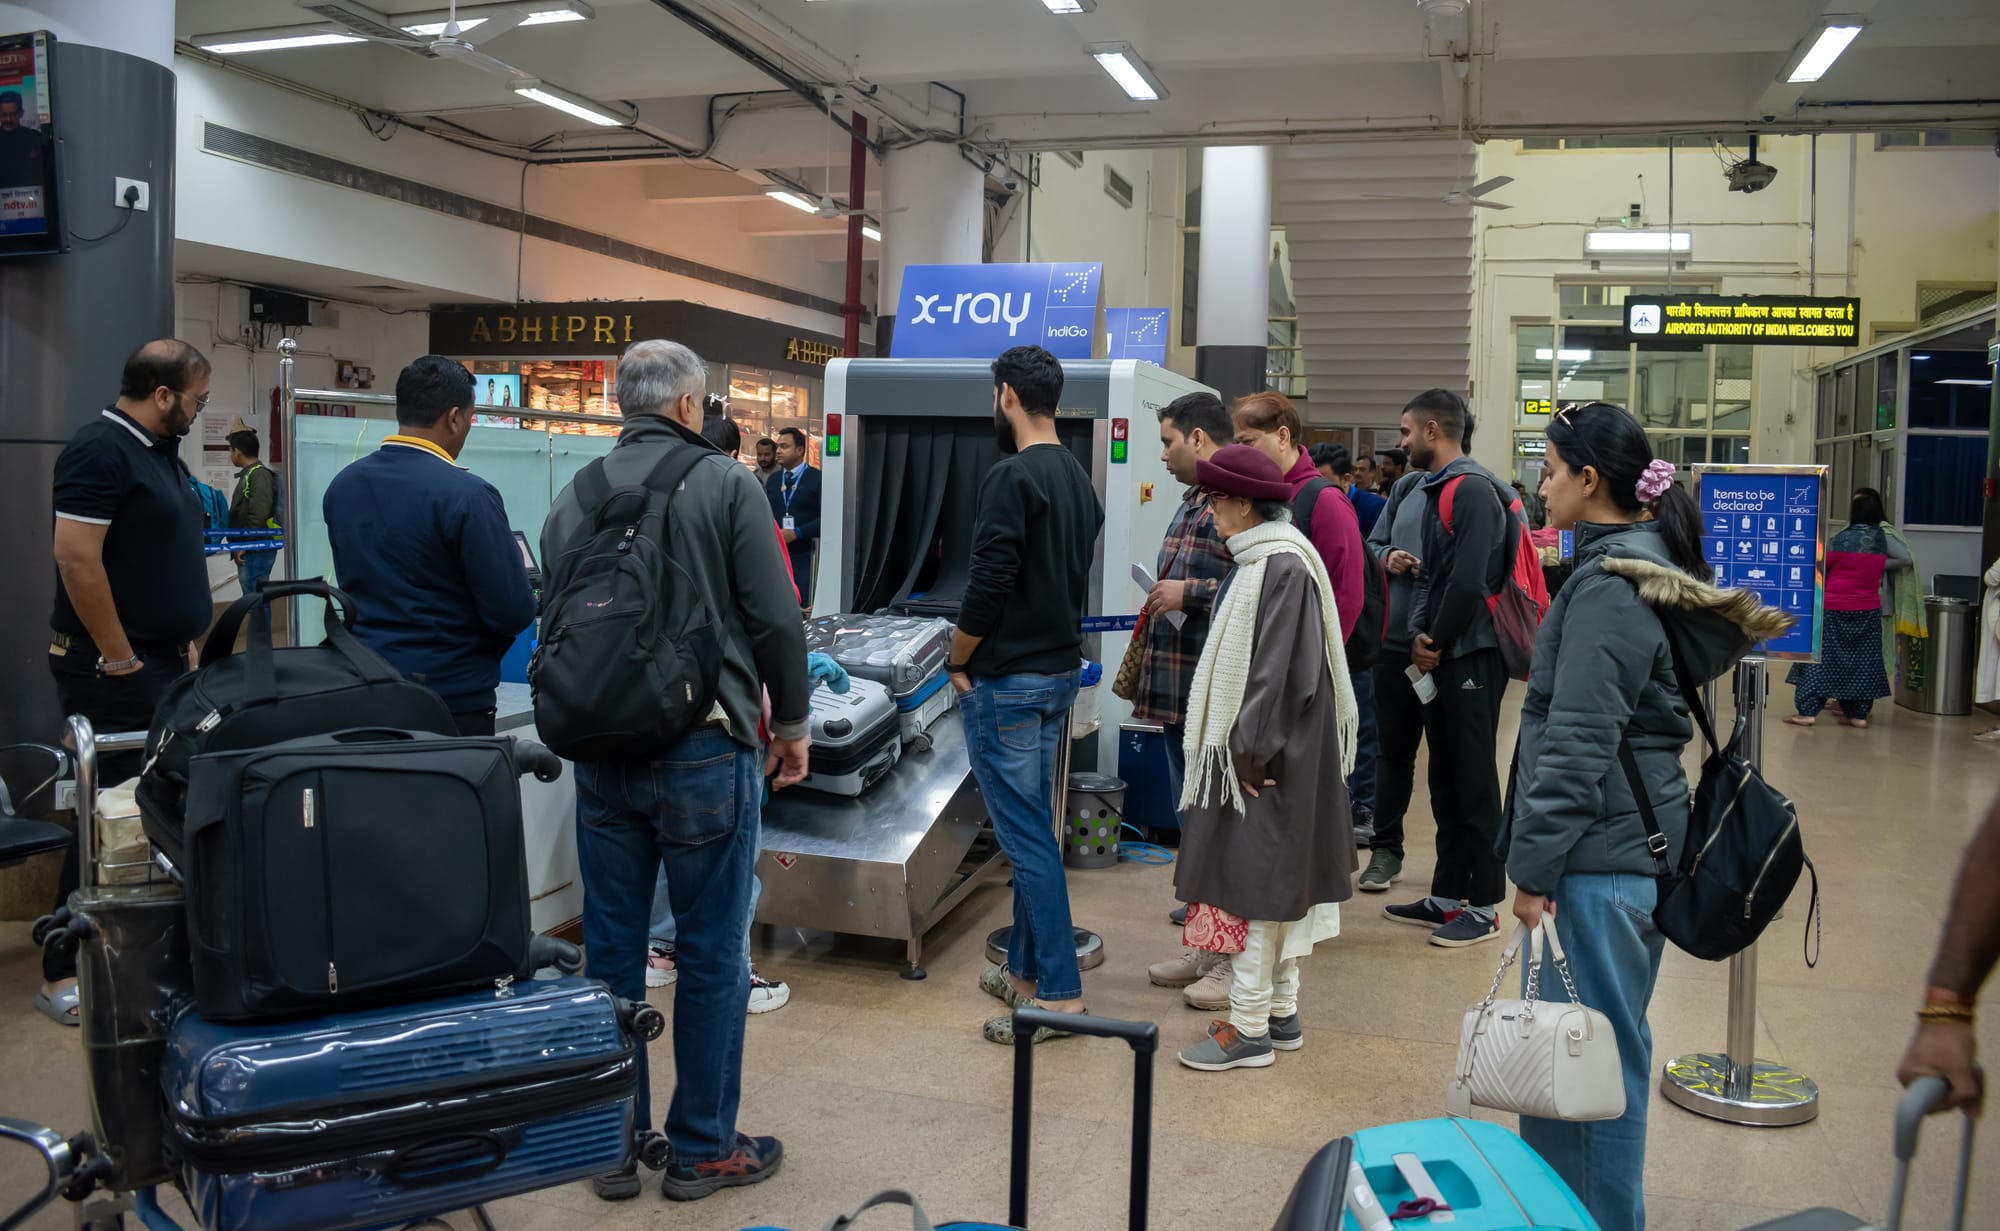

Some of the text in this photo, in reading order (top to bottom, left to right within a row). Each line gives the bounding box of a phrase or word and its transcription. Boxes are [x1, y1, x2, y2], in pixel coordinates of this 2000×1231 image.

[912, 292, 1031, 336] x-ray
[1665, 303, 1692, 318] भारतीय
[1771, 307, 1796, 318] आपका
[1799, 307, 1822, 319] स्वागत
[470, 315, 633, 343] ABHIPRI
[1048, 326, 1087, 337] IndiGo
[1665, 323, 1854, 336] AIRPORTS AUTHORITY OF INDIA WELCOMES YOU
[1714, 488, 1775, 500] Items to be
[1713, 500, 1763, 511] declared
